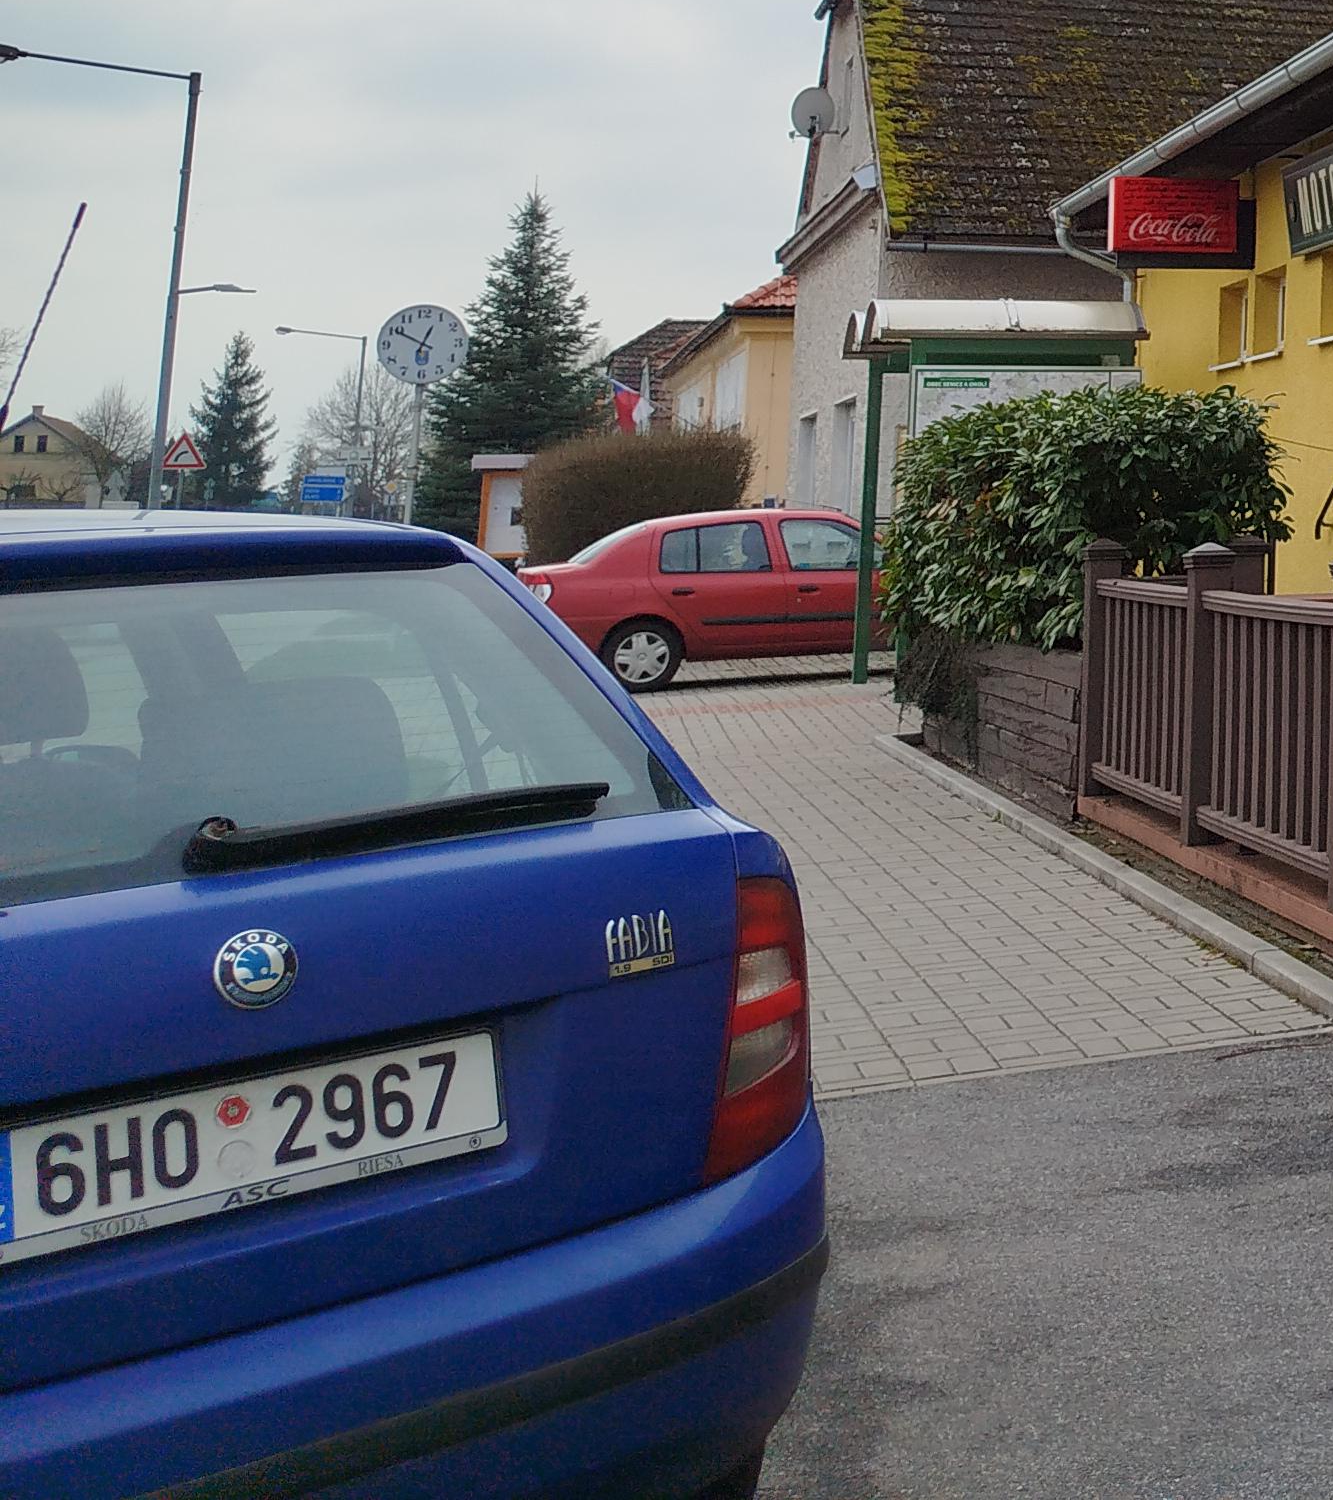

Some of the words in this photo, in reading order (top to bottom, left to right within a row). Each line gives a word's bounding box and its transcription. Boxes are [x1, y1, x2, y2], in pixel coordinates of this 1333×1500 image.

[1129, 212, 1221, 243] Coca-Cola
[401, 314, 413, 324] 11
[417, 309, 432, 319] 12
[439, 312, 444, 322] 1
[448, 322, 458, 332] 2
[382, 340, 391, 350] 9
[454, 338, 463, 348] 3
[417, 370, 426, 380] 6
[605, 909, 673, 963] FABIA
[614, 964, 632, 974] 1.9
[36, 1108, 200, 1216] 6H0
[271, 1050, 457, 1166] 2967
[220, 1179, 291, 1209] ASC
[358, 1153, 405, 1177] RIESA
